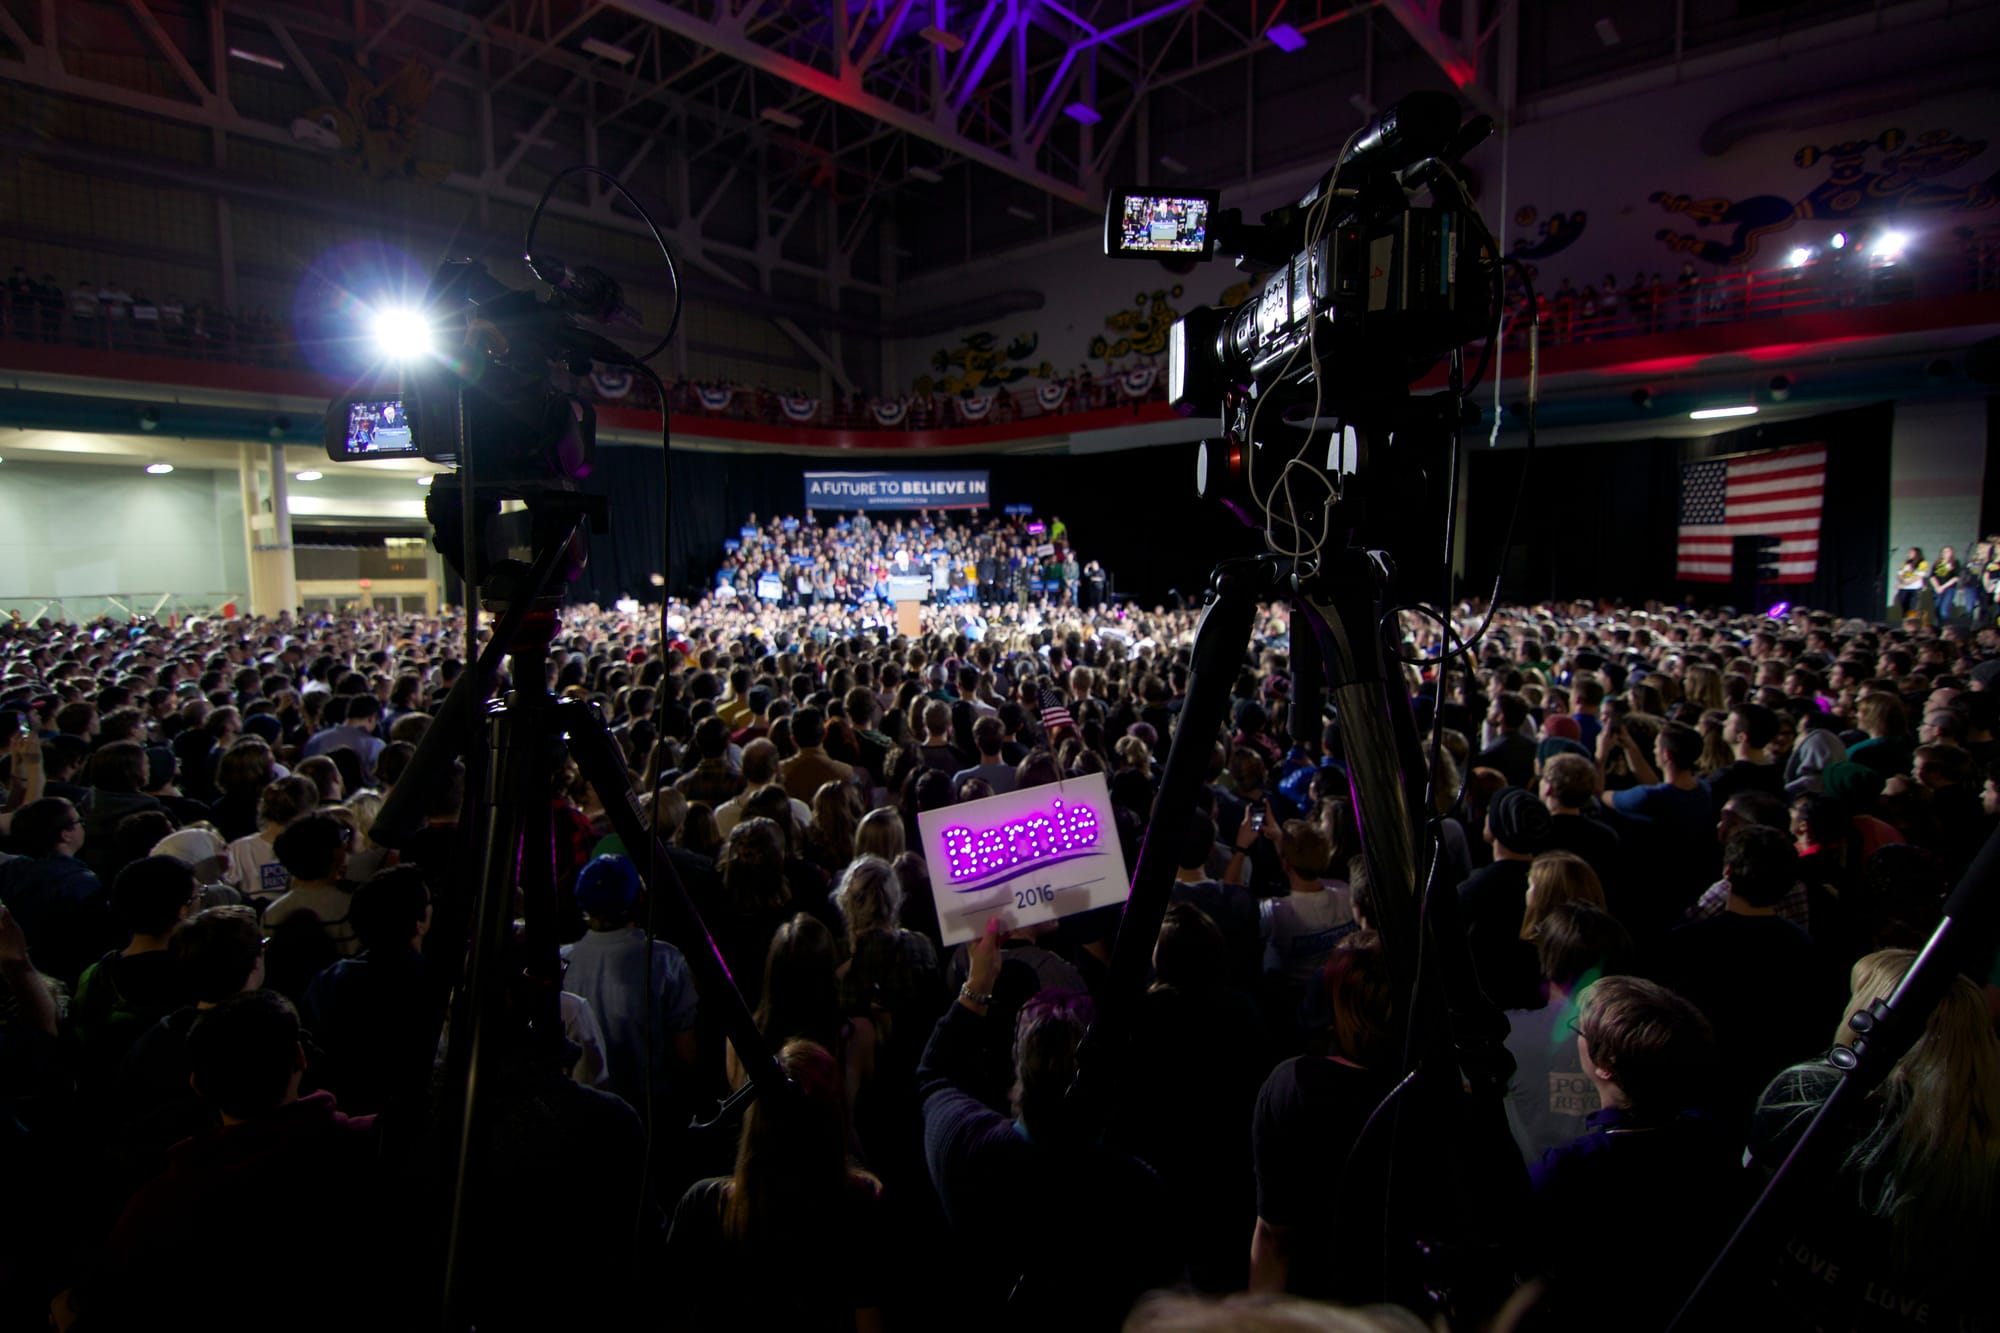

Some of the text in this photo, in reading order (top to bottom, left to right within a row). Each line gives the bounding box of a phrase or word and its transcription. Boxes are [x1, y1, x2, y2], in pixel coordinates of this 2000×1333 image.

[810, 480, 987, 496] A FUTURE TO BELIEVE IN
[942, 798, 1098, 879] Bernie
[1015, 884, 1055, 909] 2016
[1785, 1234, 1841, 1285] LOVE
[1863, 1281, 1931, 1325] LOVE
